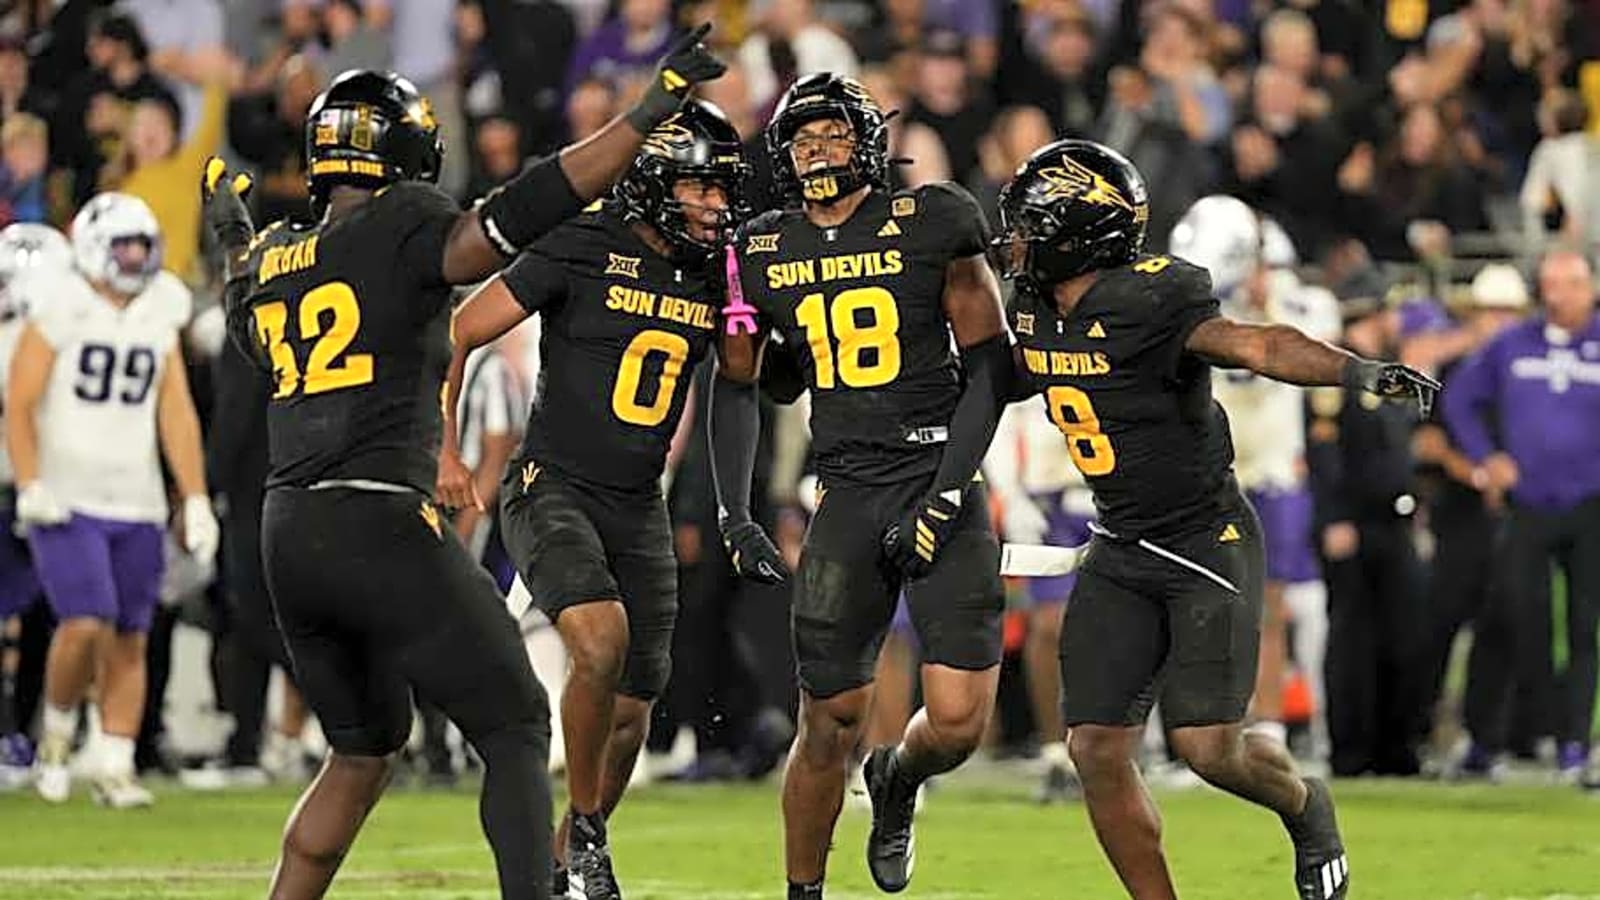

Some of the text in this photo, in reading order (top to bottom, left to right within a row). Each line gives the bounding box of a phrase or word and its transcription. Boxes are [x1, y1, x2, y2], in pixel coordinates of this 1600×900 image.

[605, 284, 656, 317] SUN
[767, 259, 815, 289] SUN
[820, 250, 903, 282] DEVILS
[75, 344, 156, 405] 99
[254, 281, 373, 399] 32
[795, 286, 900, 389] 18
[1051, 351, 1111, 375] DEVILS
[612, 329, 689, 427] 0
[1047, 385, 1116, 476] 8
